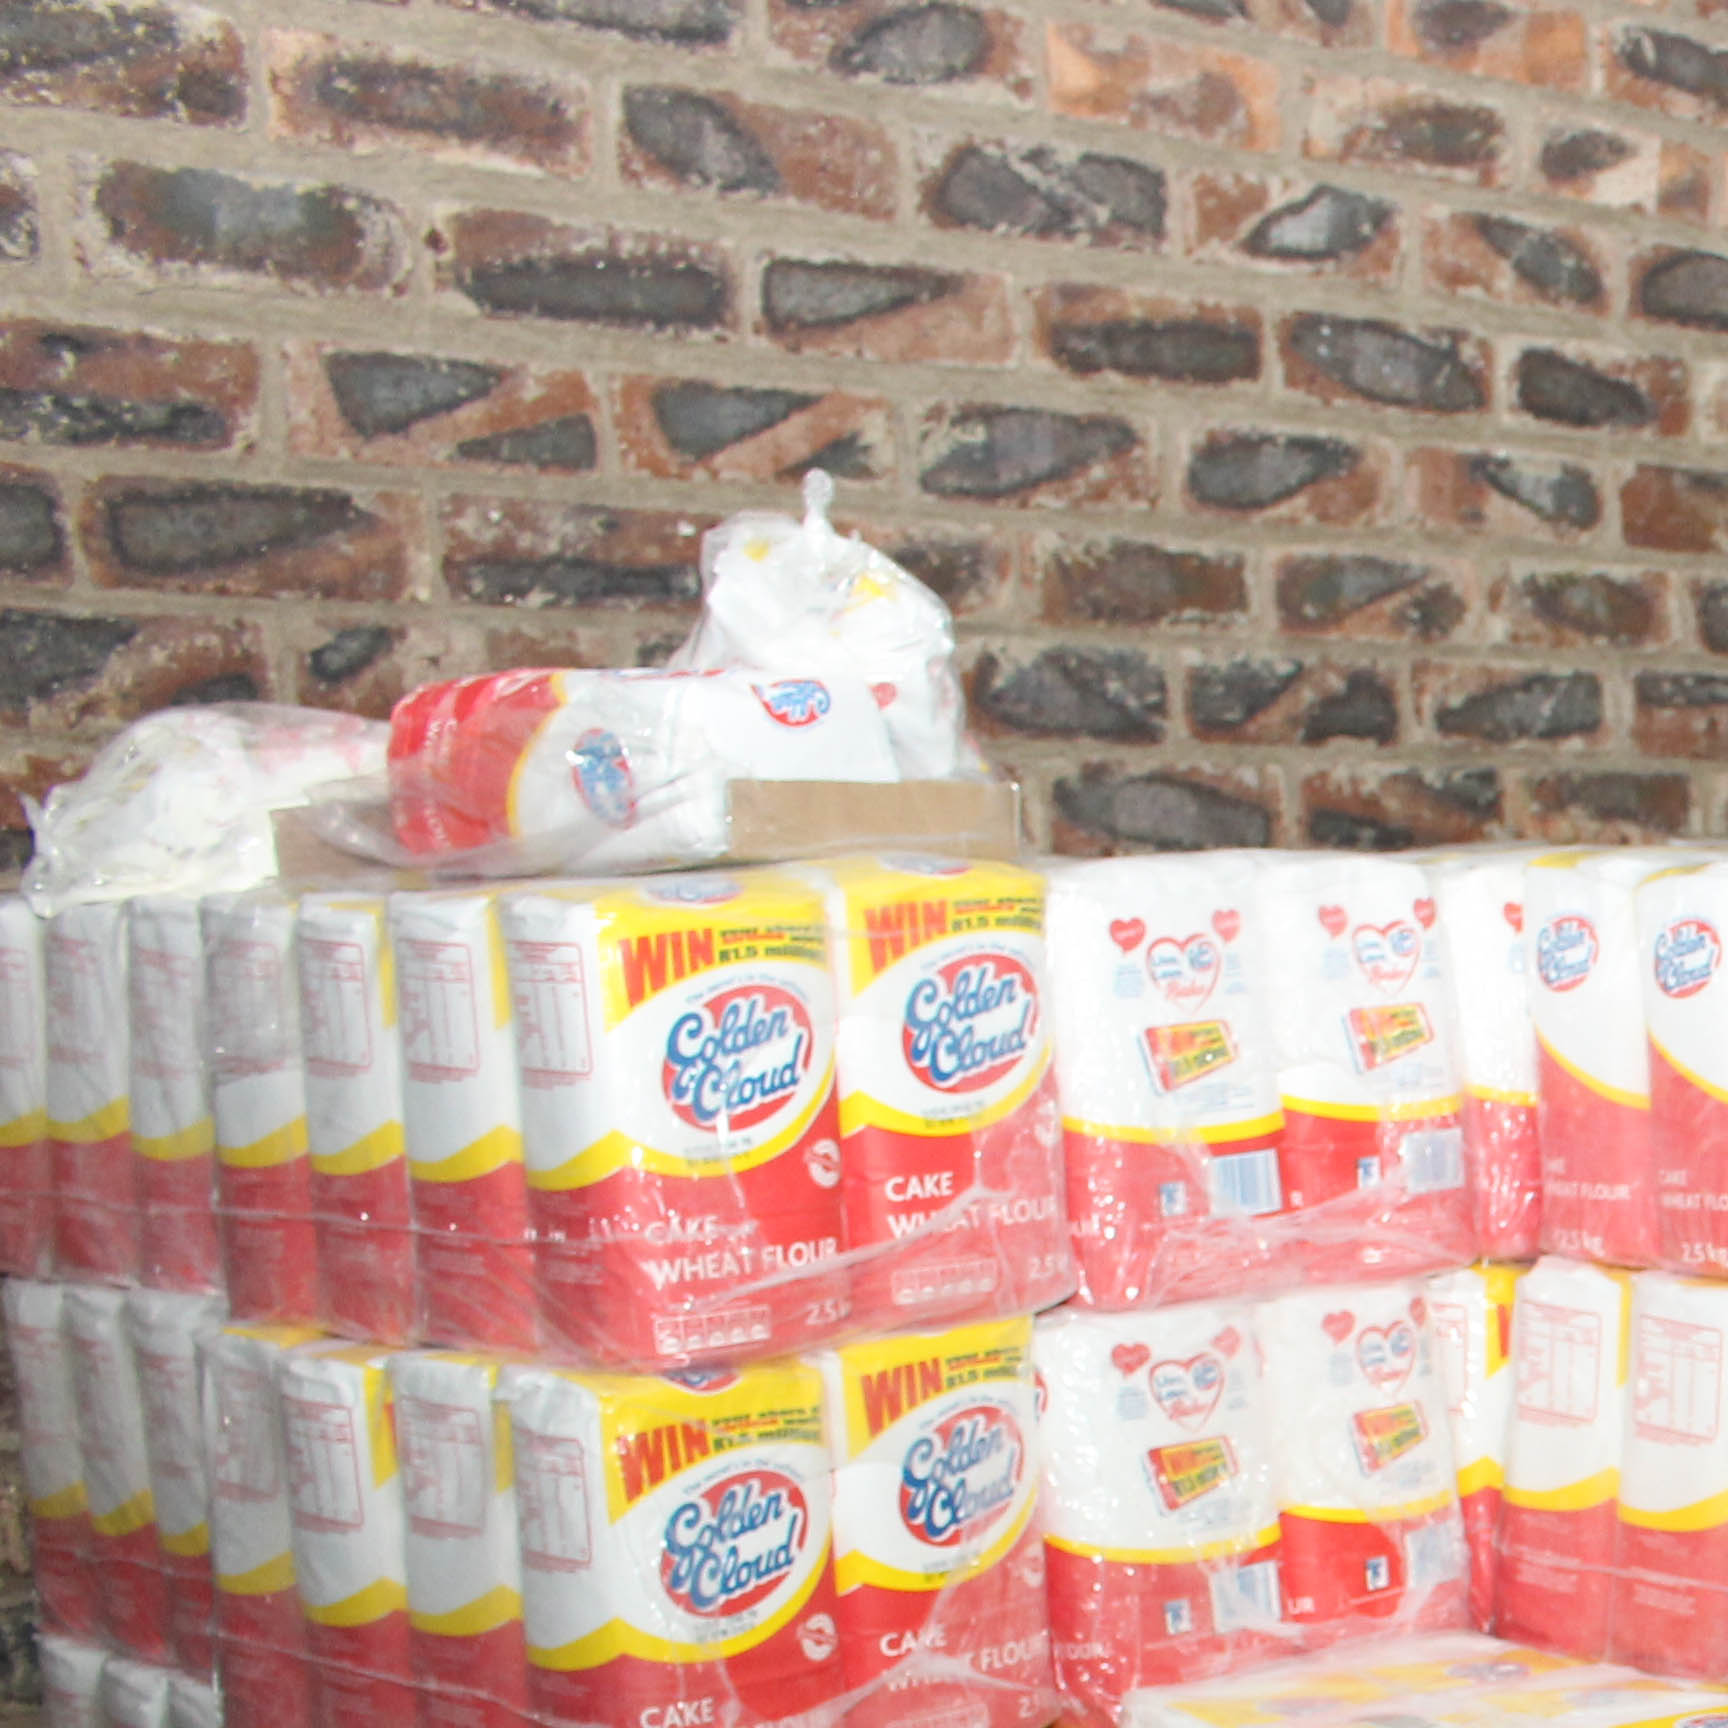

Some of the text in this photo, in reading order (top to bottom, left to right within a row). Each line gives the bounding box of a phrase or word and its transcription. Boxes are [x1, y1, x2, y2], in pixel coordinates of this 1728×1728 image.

[620, 928, 715, 1008] WIN
[864, 899, 948, 974] WIN
[666, 994, 789, 1101] Golden
[905, 963, 1018, 1066] Golden
[930, 998, 1026, 1083] Cloud
[692, 1035, 801, 1122] Cloud
[884, 1171, 954, 1202] CAKE
[763, 1238, 838, 1272] FLOUR
[861, 1358, 943, 1438] WIN
[616, 1419, 711, 1504] WIN
[664, 1479, 782, 1591] Golden
[692, 1513, 795, 1609] Cloud
